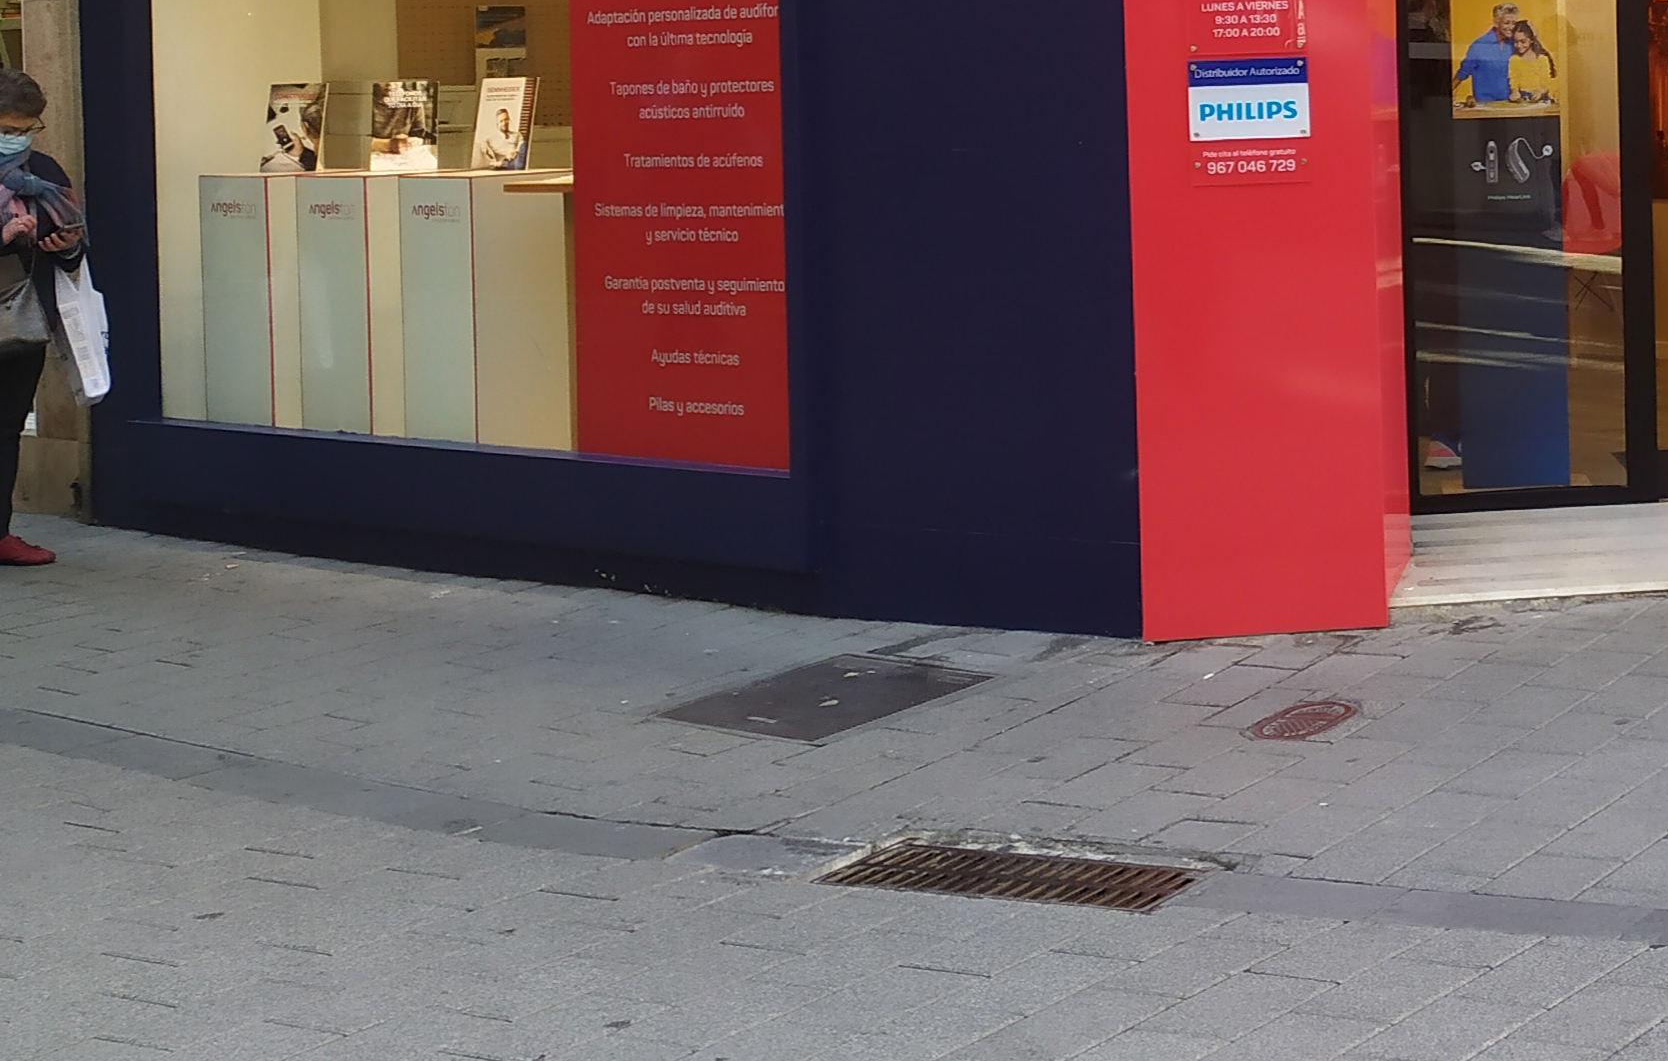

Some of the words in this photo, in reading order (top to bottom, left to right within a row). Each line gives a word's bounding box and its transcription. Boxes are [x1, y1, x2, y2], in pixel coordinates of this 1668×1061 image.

[1201, 1, 1235, 12] LUNES
[1236, 1, 1245, 11] A
[1245, 0, 1289, 11] VIERNES
[587, 8, 646, 27] Adaptación
[648, 5, 721, 26] personalizada
[723, 5, 738, 19] de
[1214, 14, 1238, 25] 9:30
[1239, 14, 1248, 24] A
[1249, 13, 1277, 24] 13:30
[626, 35, 647, 47] con
[648, 32, 658, 47] la
[660, 31, 694, 46] última
[695, 28, 753, 48] tecnología
[1212, 28, 1240, 38] 17:00
[1241, 28, 1249, 37] A
[1250, 26, 1281, 37] 20:00
[1194, 66, 1248, 80] Distribuidor
[1249, 65, 1300, 77] Autorizado
[610, 81, 655, 98] Tapones
[656, 80, 670, 95] de
[671, 79, 698, 94] baño
[700, 82, 708, 98] y
[709, 79, 775, 97] protectores
[639, 104, 690, 119] acústicos
[692, 103, 745, 119] antirruido
[1199, 100, 1299, 122] PHILIPS
[624, 153, 695, 168] Tratamientos
[697, 153, 710, 167] de
[712, 152, 764, 167] acúfenos
[1206, 160, 1235, 175] 967
[1237, 159, 1266, 173] 046
[1268, 158, 1296, 172] 729
[594, 202, 643, 217] Sistemas
[645, 202, 658, 217] de
[660, 202, 707, 220] limpieza,
[645, 231, 653, 246] y
[654, 227, 696, 242] servicio
[698, 227, 739, 242] técnico
[604, 275, 649, 290] Garantía
[651, 277, 705, 293] postventa
[707, 279, 715, 295] y
[717, 277, 785, 295] seguimiento
[641, 300, 655, 315] de
[657, 303, 670, 315] su
[672, 300, 701, 316] salud
[703, 301, 747, 317] auditiva
[651, 348, 691, 367] Ayudas
[693, 350, 740, 366] técnicas
[648, 396, 675, 412] Pilas
[677, 401, 684, 416] y
[686, 400, 745, 416] accesorios
